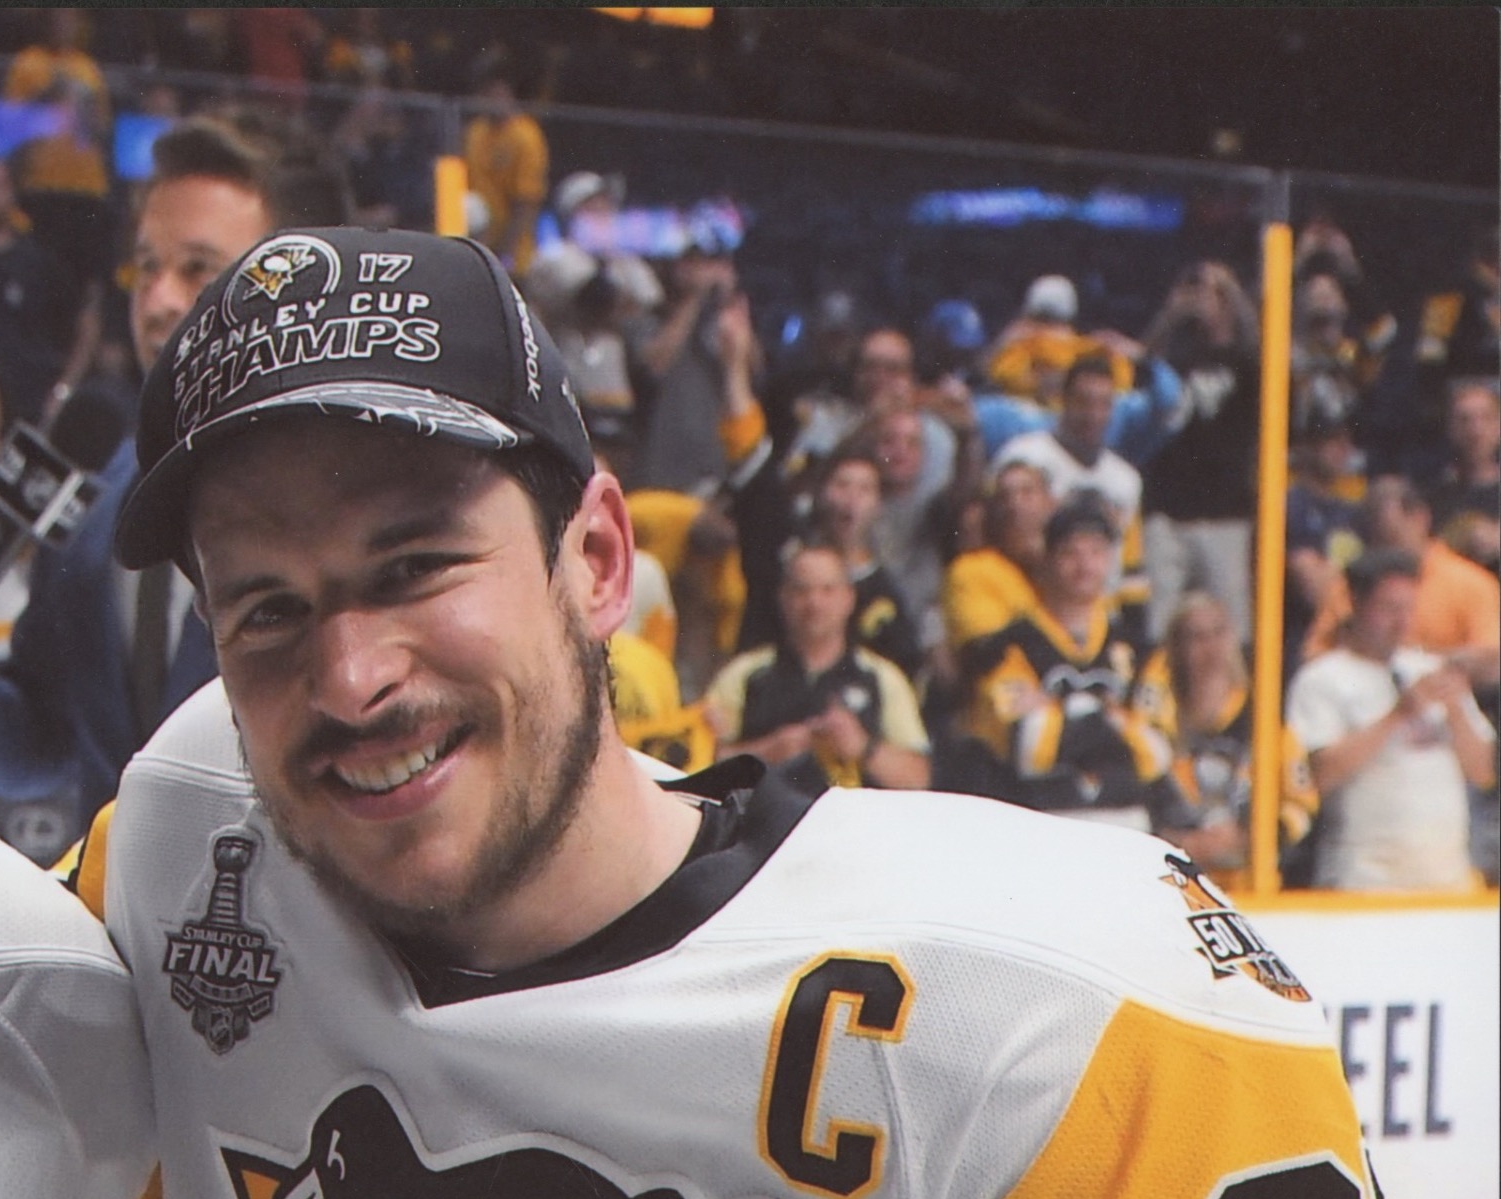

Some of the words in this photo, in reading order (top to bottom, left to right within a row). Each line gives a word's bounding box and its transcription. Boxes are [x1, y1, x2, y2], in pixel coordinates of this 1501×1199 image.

[358, 253, 412, 283] 17
[174, 298, 326, 400] STANLEY
[350, 292, 429, 314] CUP
[175, 316, 440, 443] CHAMPS
[183, 926, 236, 947] STANLEY
[237, 933, 262, 948] CUP
[1192, 915, 1244, 958] 50
[168, 941, 275, 983] FINAL
[1322, 1000, 1451, 1137] EEL
